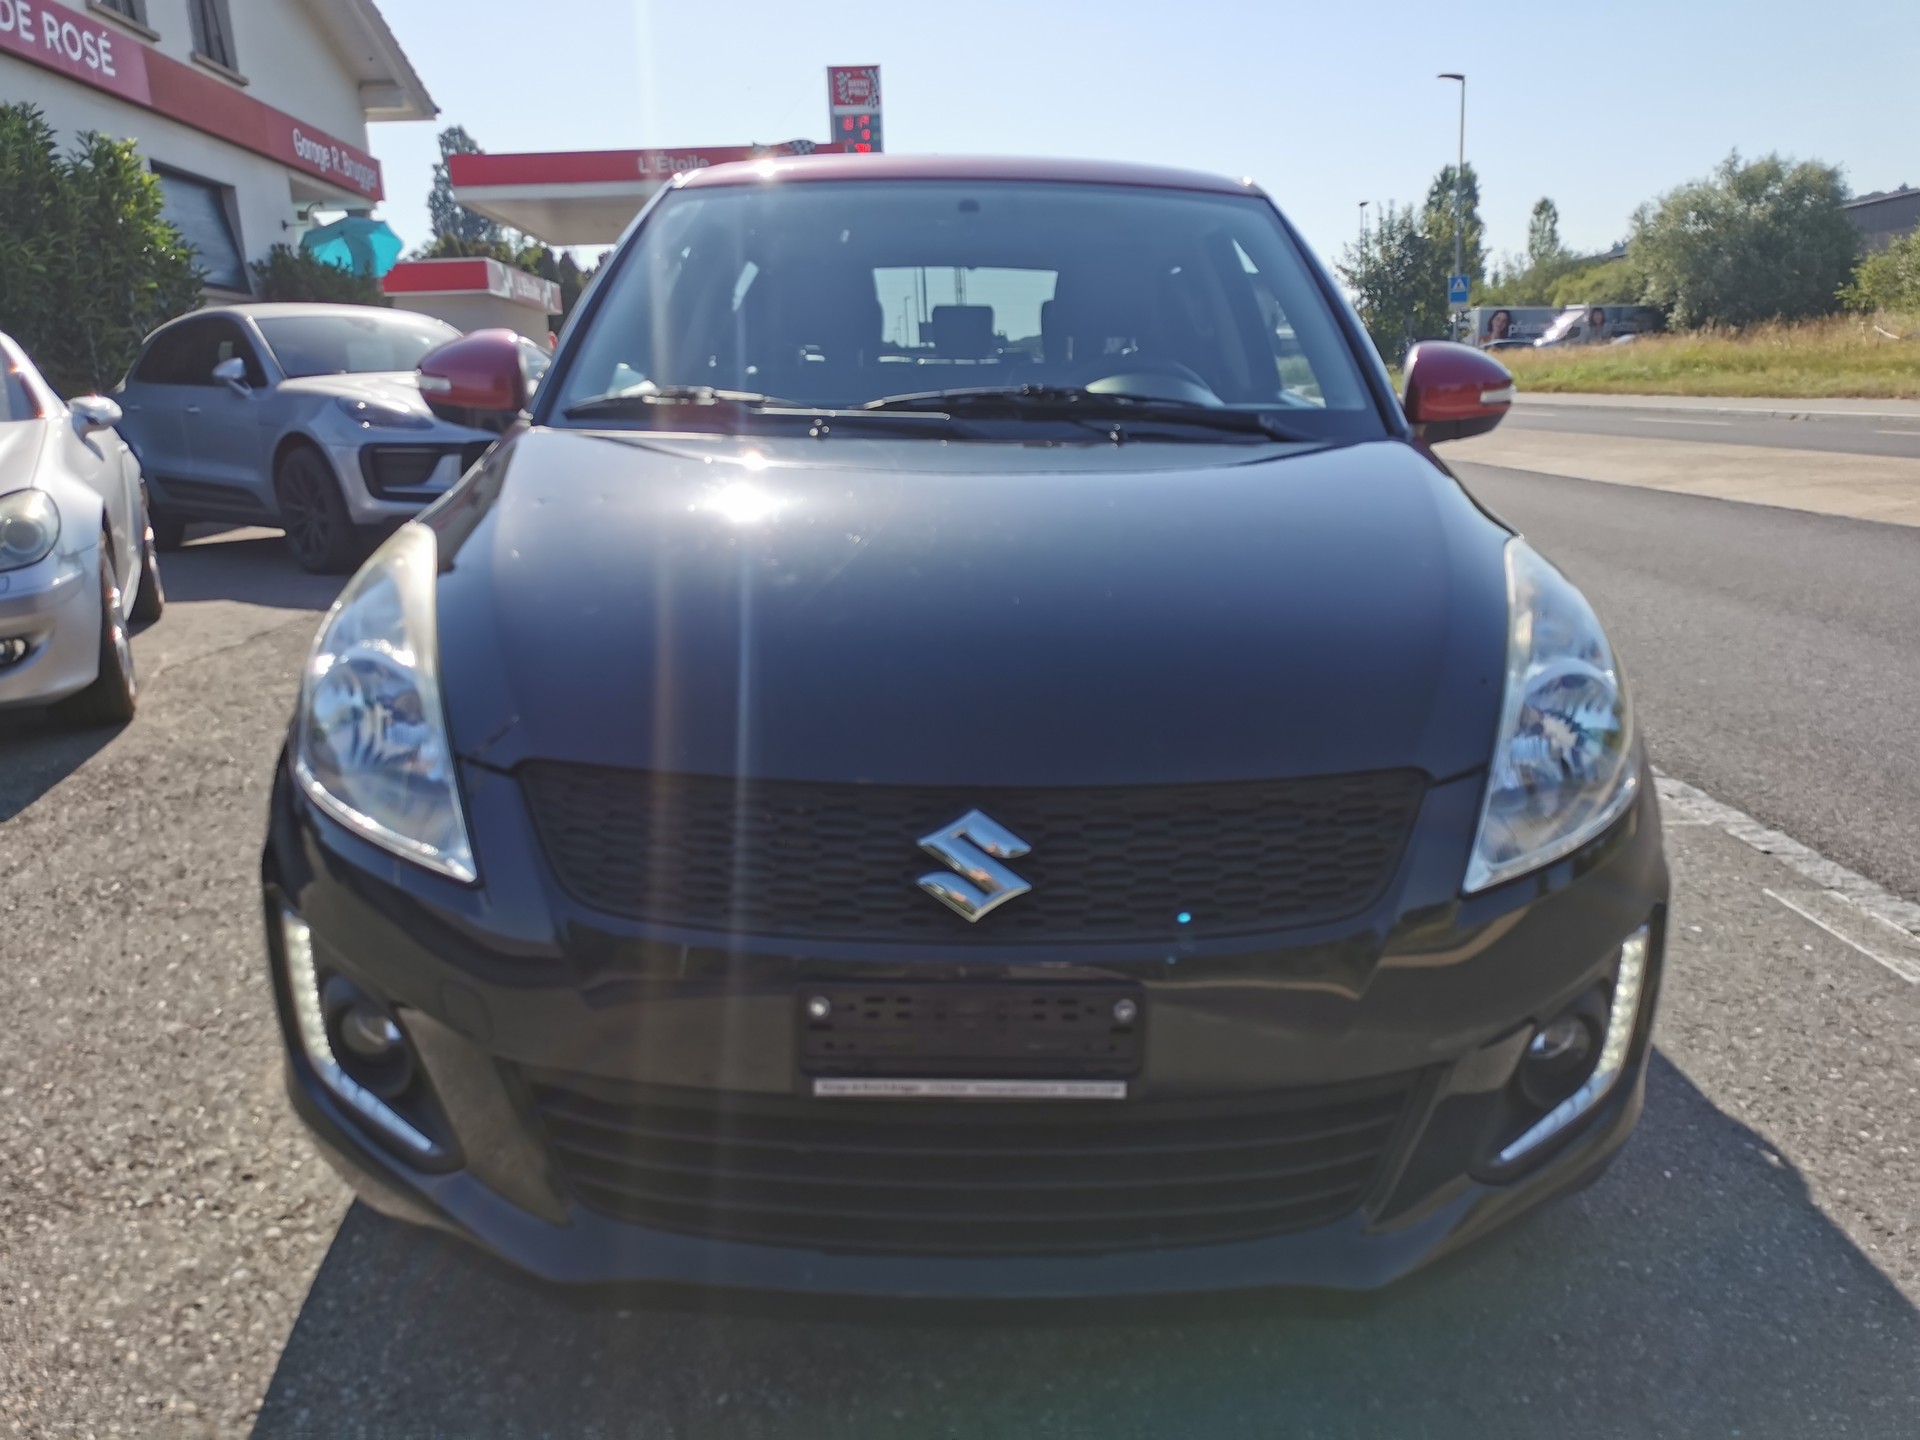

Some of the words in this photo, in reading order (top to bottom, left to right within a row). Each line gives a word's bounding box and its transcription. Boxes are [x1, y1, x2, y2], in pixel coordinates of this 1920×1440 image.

[0, 0, 35, 42] DE
[41, 10, 117, 77] ROSÉ
[292, 127, 331, 173] Garage
